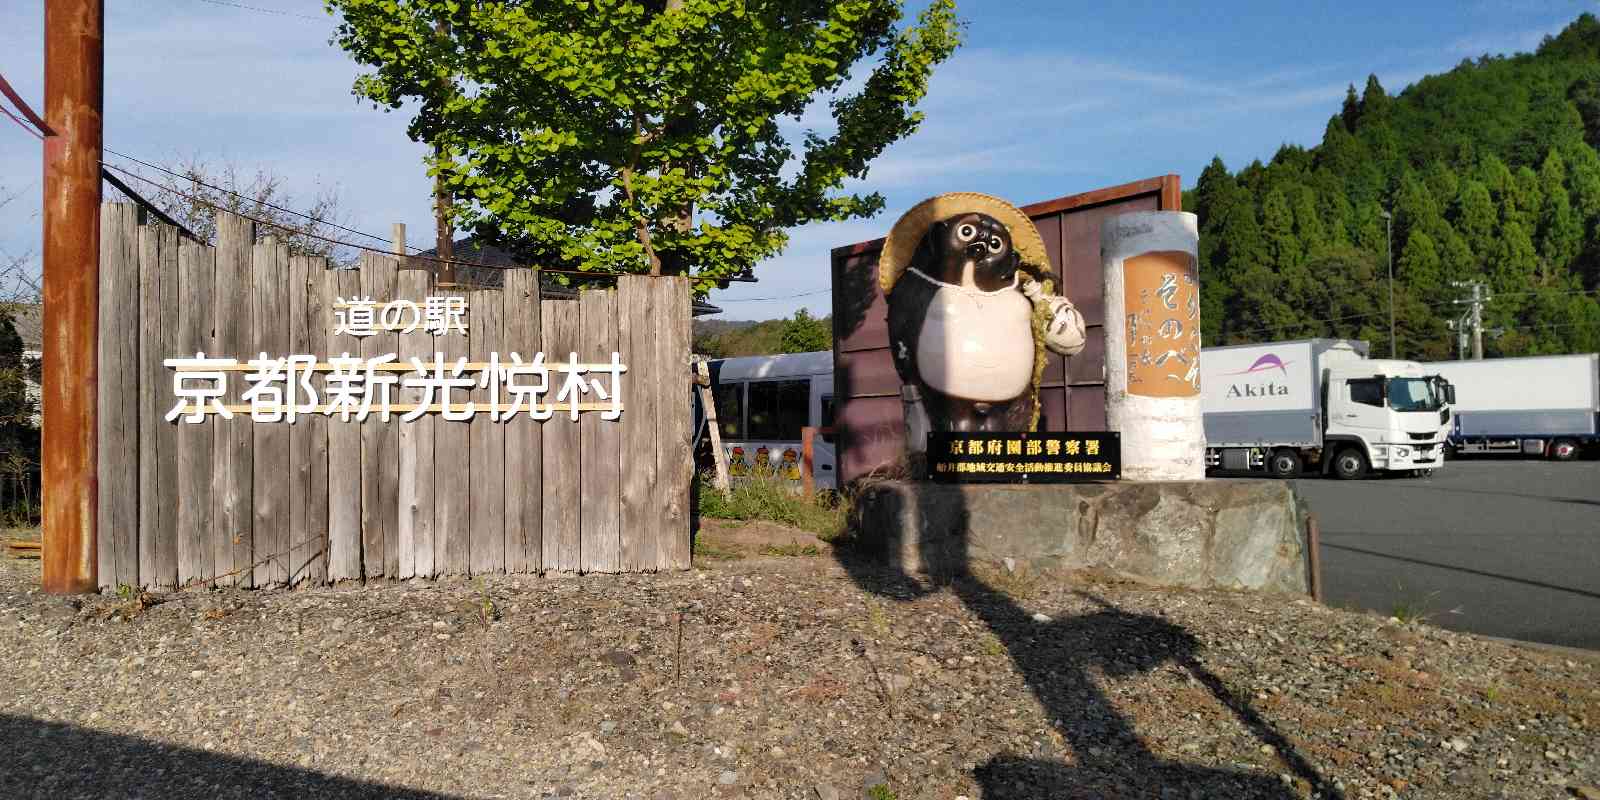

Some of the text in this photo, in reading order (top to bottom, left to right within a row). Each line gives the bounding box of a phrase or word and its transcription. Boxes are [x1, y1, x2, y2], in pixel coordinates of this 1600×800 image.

[334, 295, 468, 337] 道の駅
[164, 352, 627, 423] 京都新光悦村
[1226, 382, 1289, 398] Akita
[950, 439, 1100, 455] 京都府園部警察署
